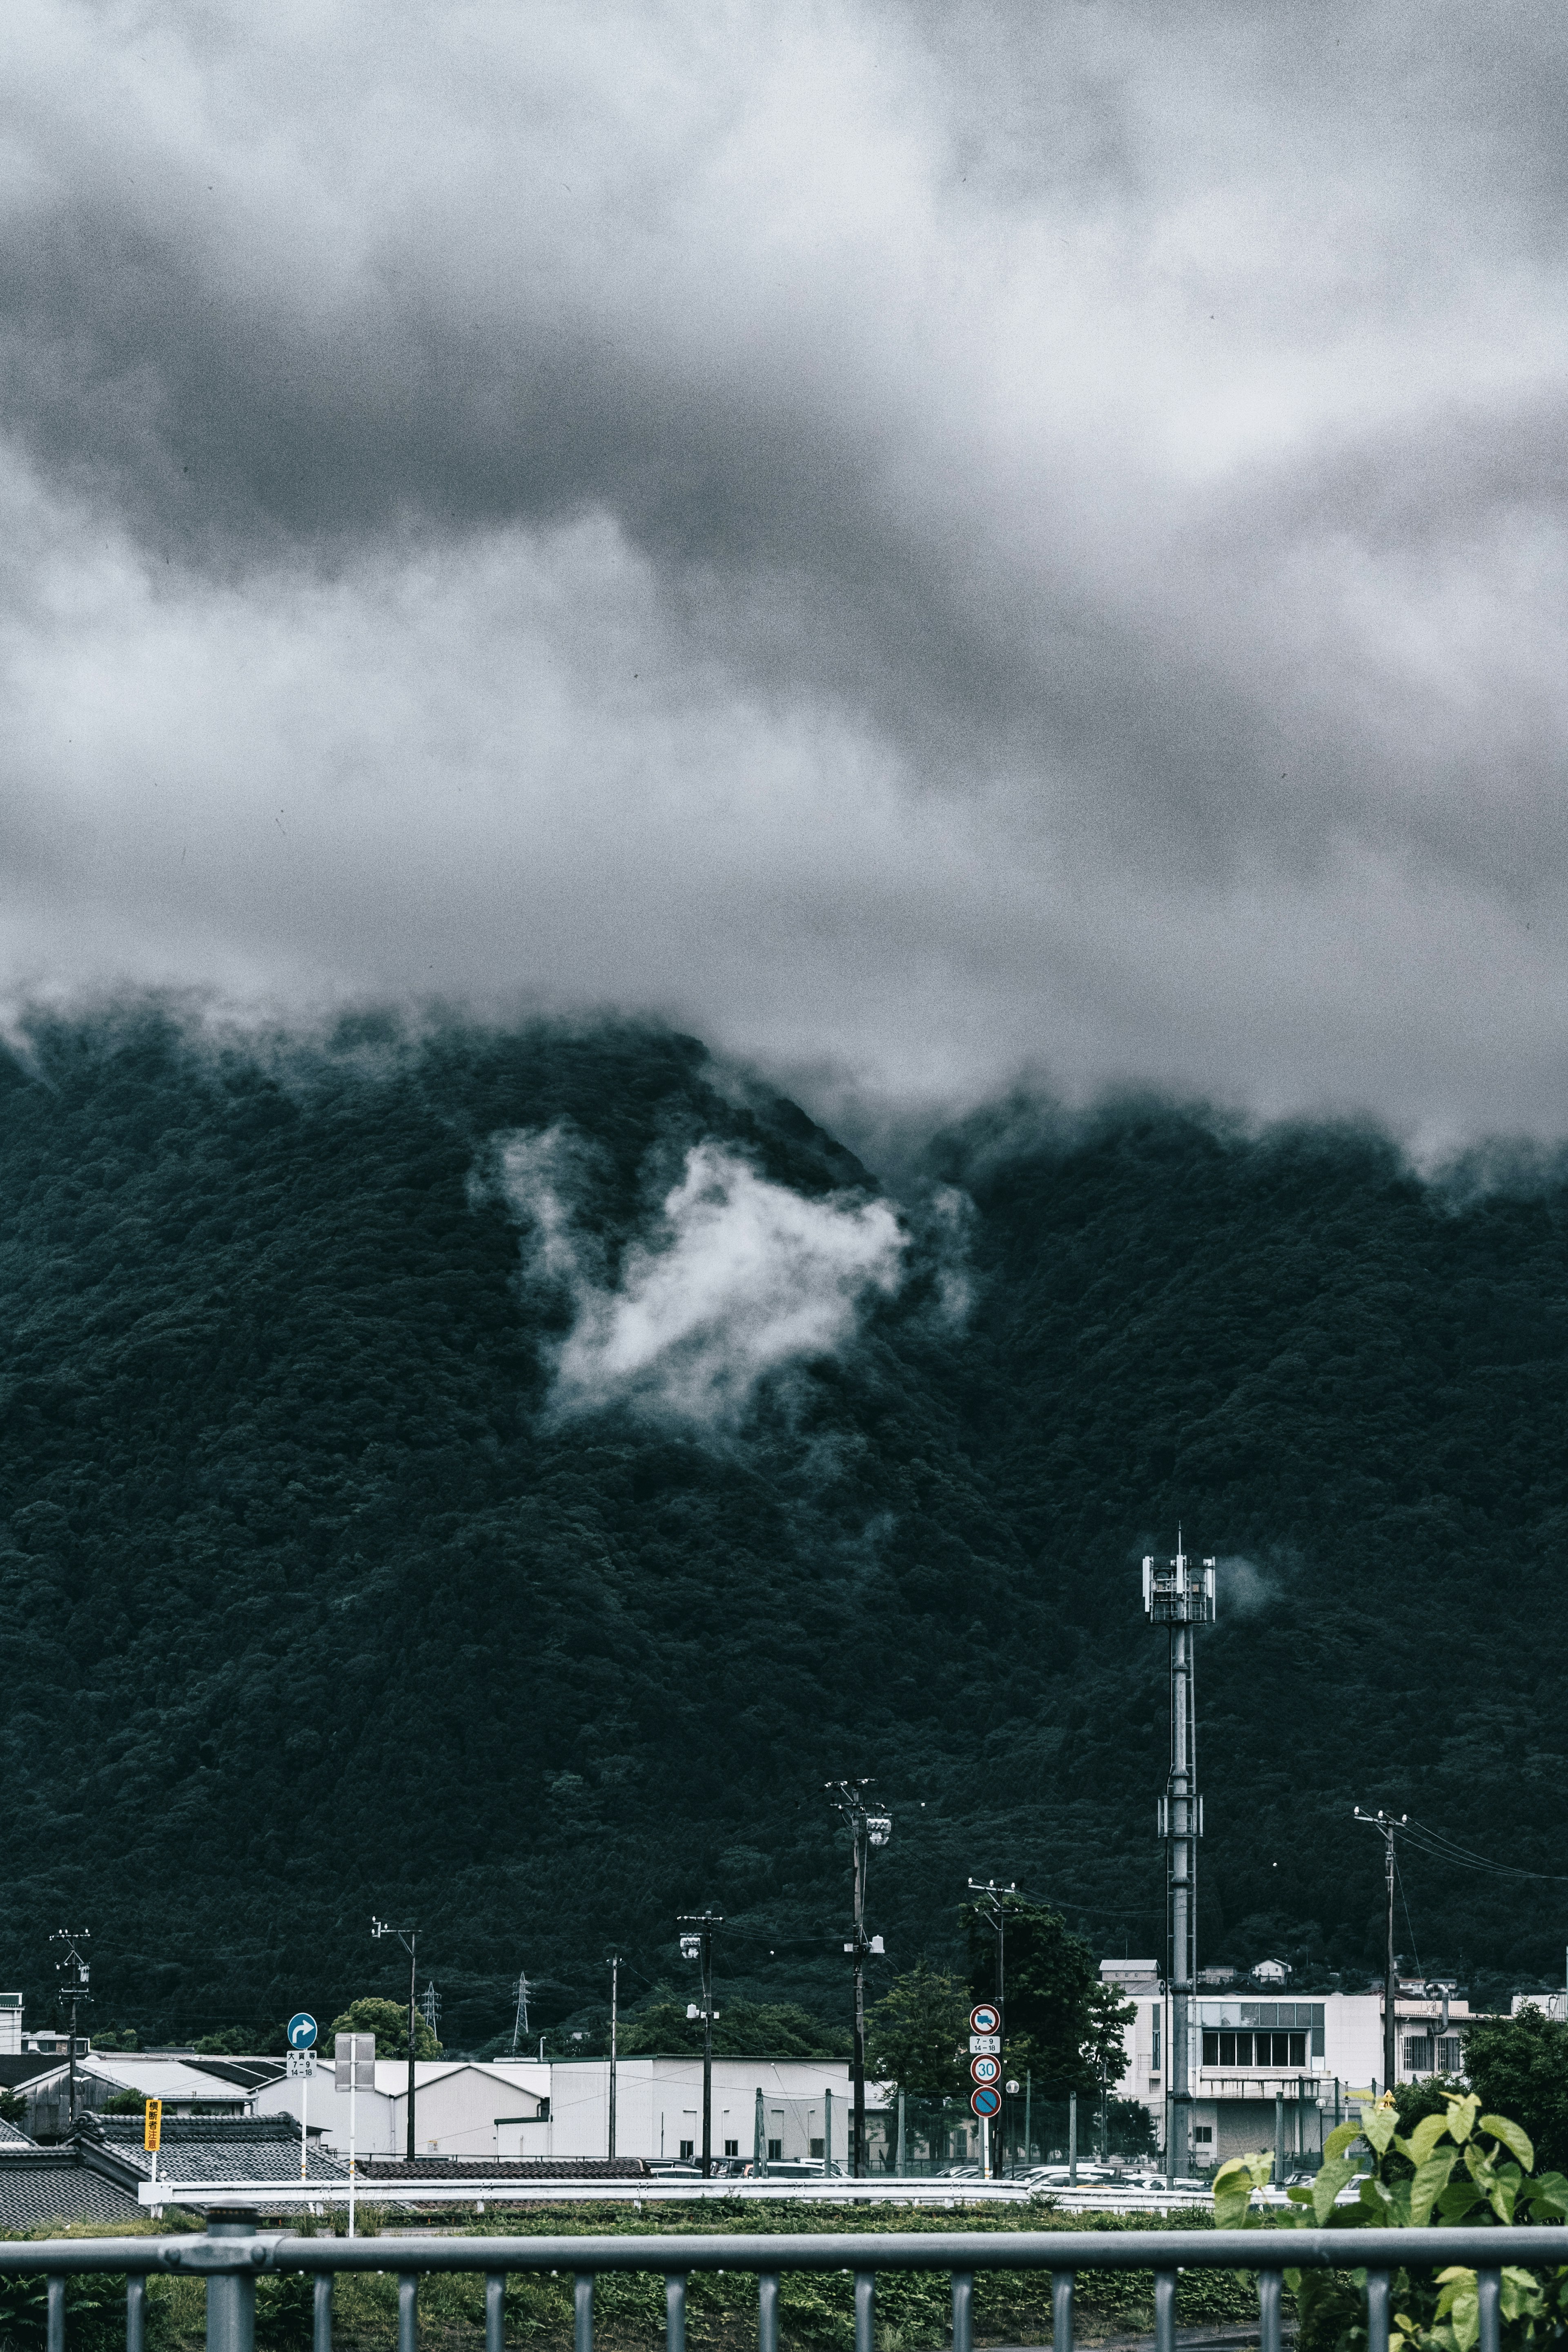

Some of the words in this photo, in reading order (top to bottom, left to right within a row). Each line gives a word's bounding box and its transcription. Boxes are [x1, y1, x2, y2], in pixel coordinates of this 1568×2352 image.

[978, 2063, 994, 2076] 30
[148, 2101, 158, 2149] 横断者注意
